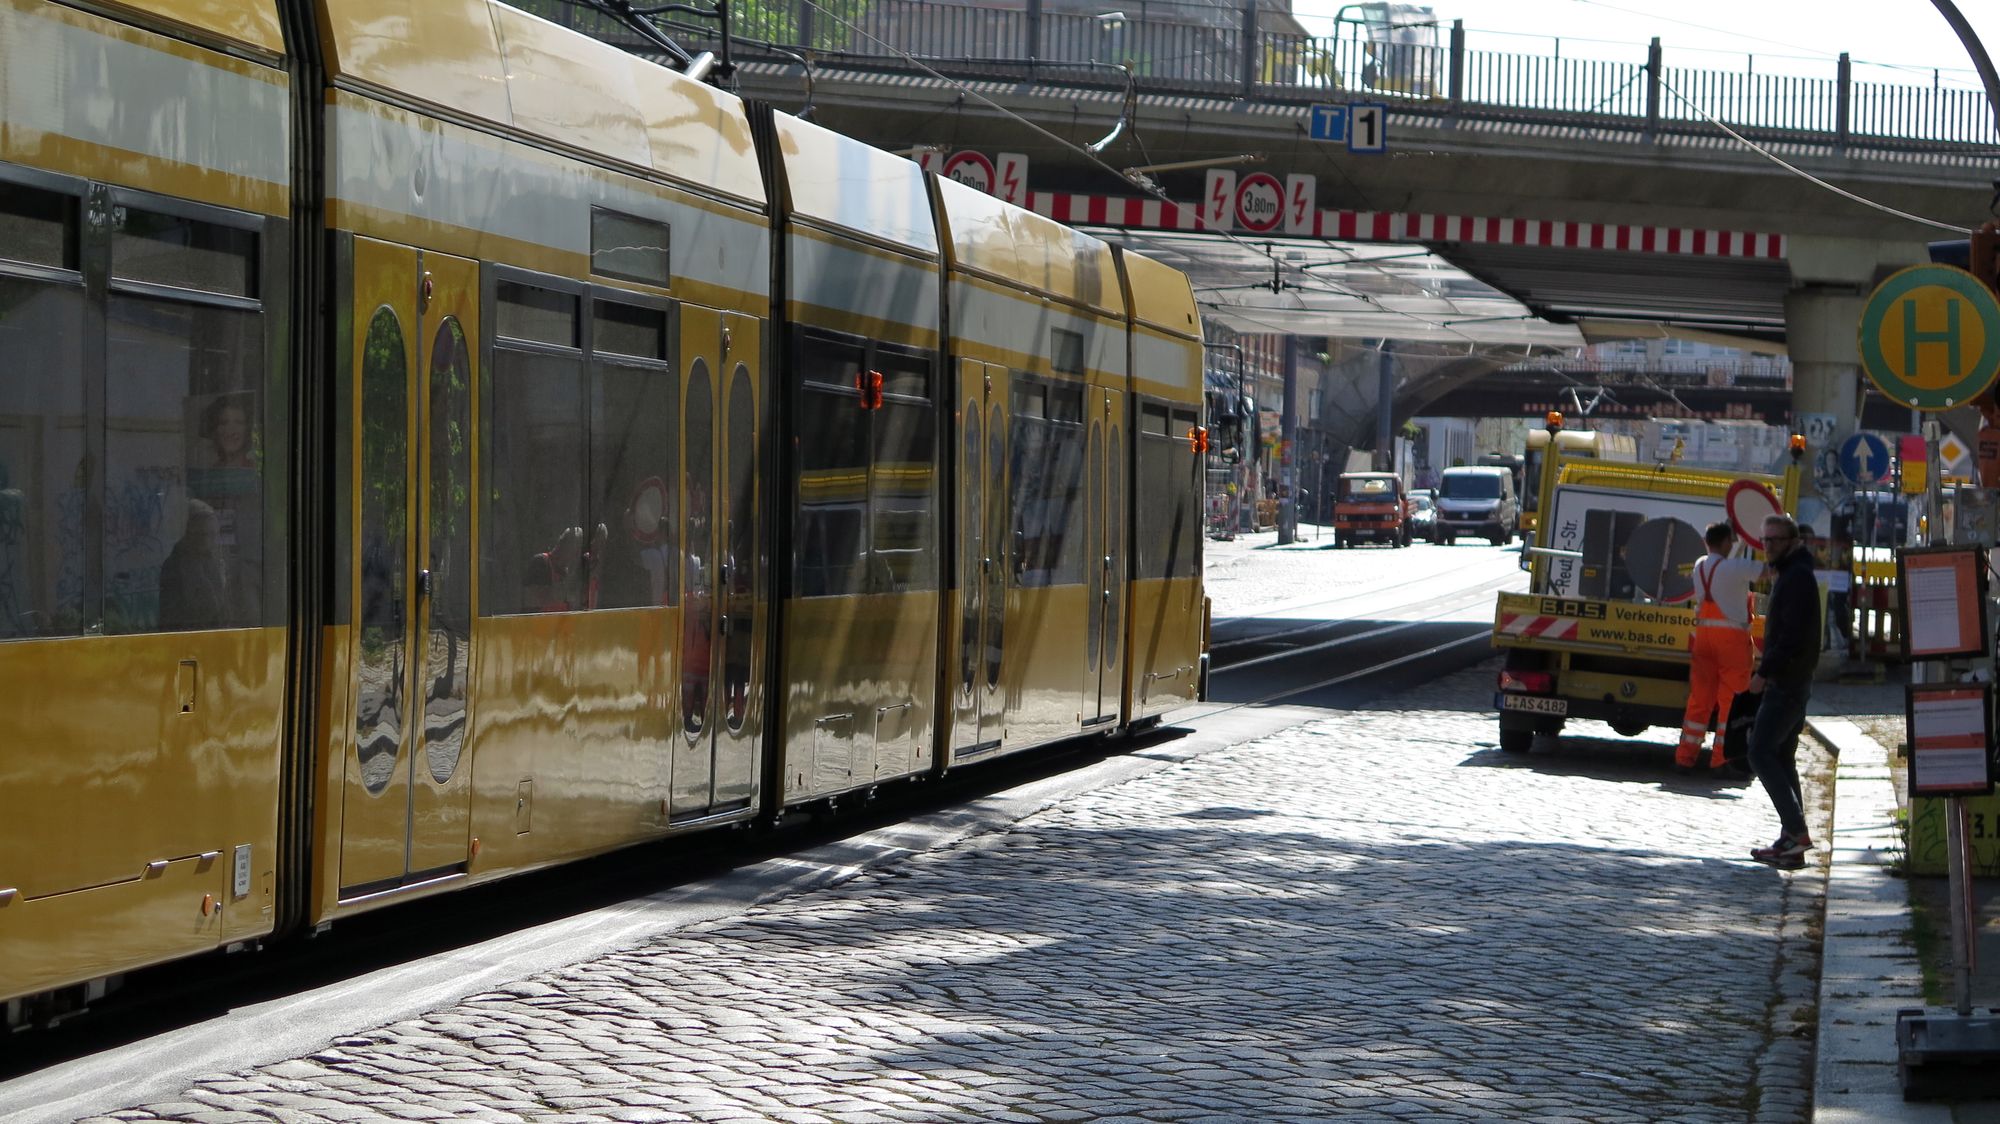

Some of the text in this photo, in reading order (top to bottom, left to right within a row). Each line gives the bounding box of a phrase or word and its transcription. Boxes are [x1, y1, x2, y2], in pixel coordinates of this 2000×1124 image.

[1319, 108, 1340, 137] T
[1359, 109, 1376, 146] 1
[1903, 298, 1962, 377] H
[1555, 519, 1578, 595] -Reutr-Str.
[1542, 599, 1604, 619] B.A.S.
[1590, 628, 1676, 646] www.bas.de
